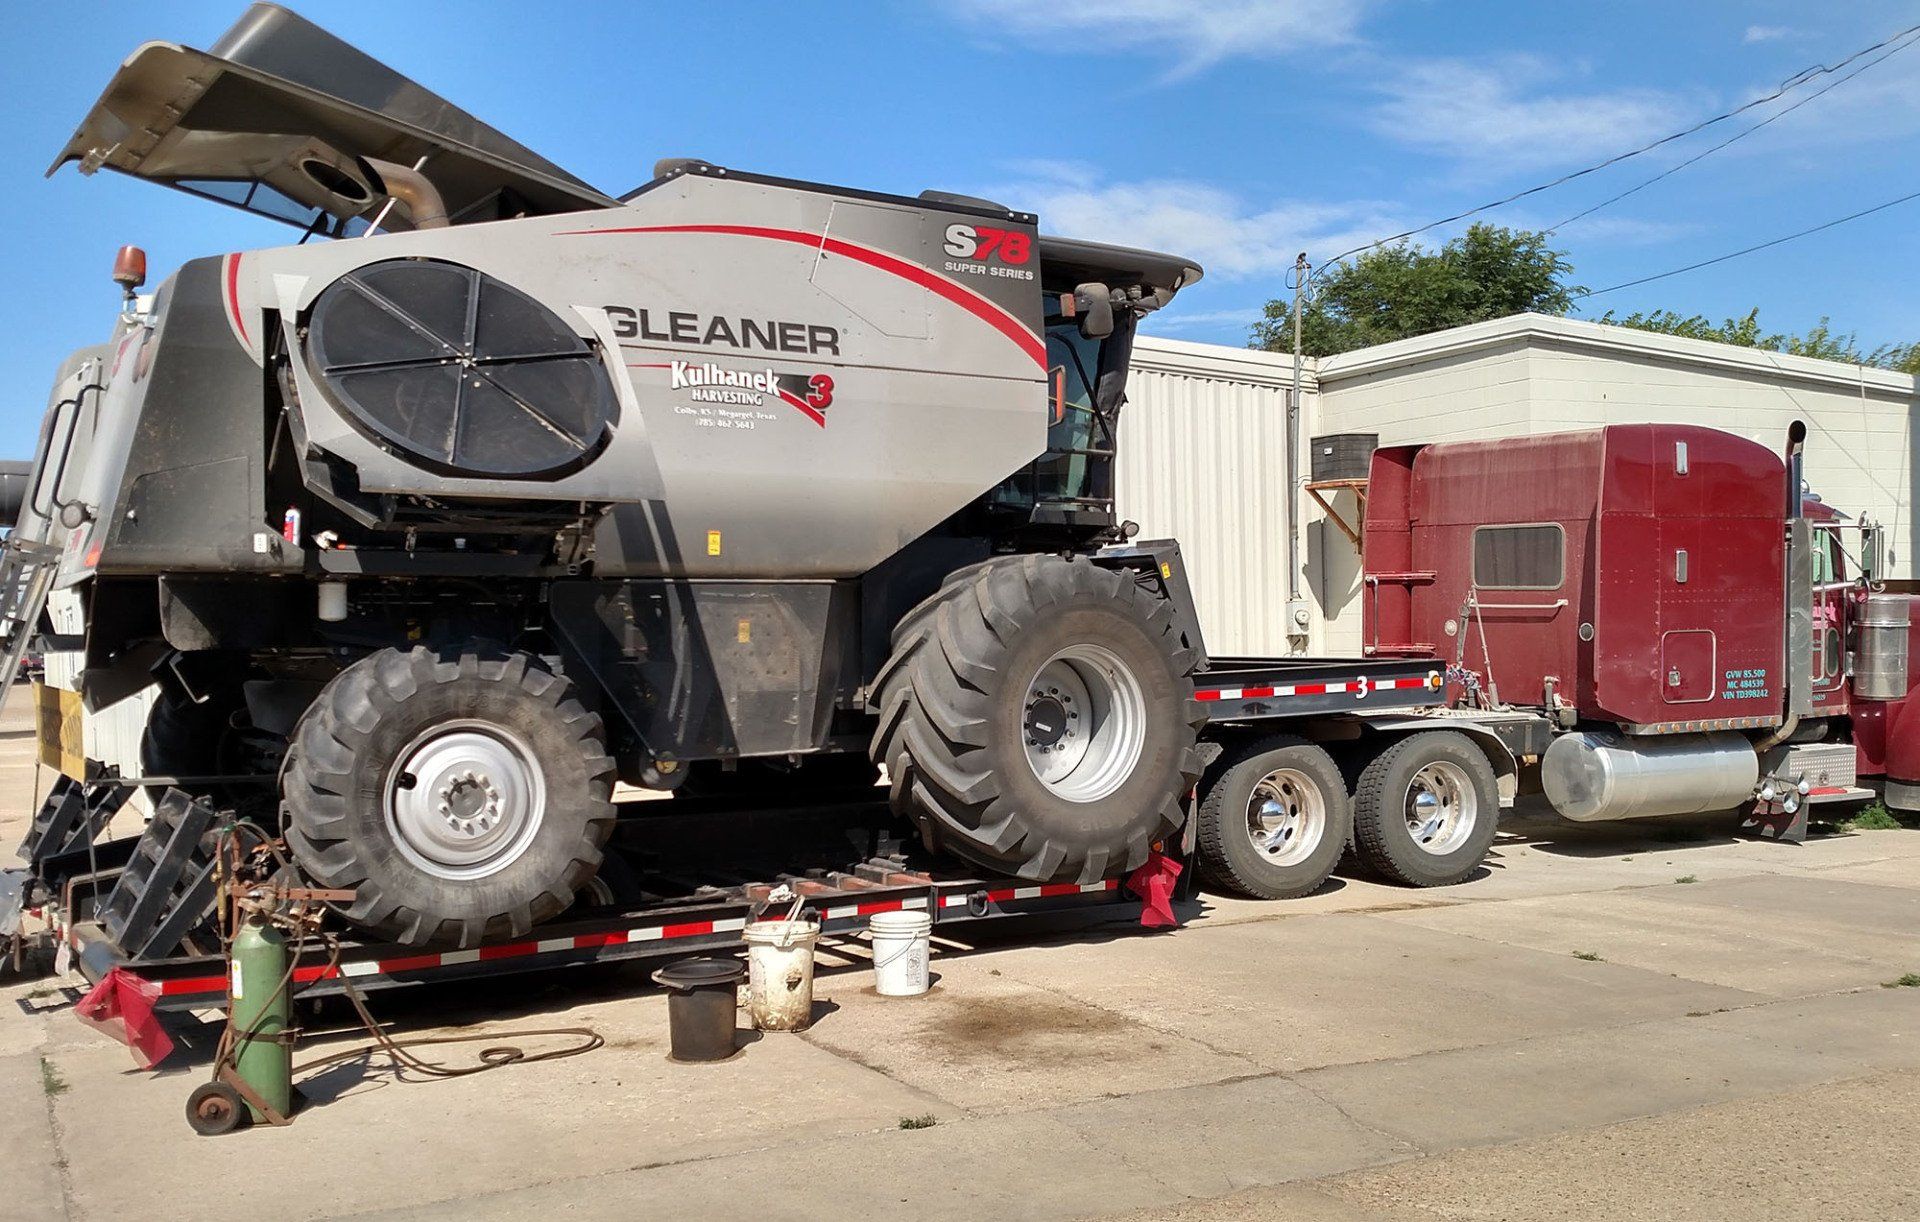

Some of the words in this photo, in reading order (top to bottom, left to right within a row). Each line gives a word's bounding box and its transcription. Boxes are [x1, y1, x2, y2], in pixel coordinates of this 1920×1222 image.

[944, 223, 1031, 265] S78
[944, 261, 986, 275] SUPER
[990, 267, 1034, 281] SERIES
[602, 305, 841, 356] GLEANER
[671, 360, 781, 397] Kulhanek
[691, 389, 763, 406] HARVESTING
[807, 373, 835, 409] 3
[756, 411, 778, 420] Texas
[1725, 670, 1742, 679] GVW
[1355, 675, 1368, 699] 3
[1727, 681, 1739, 689] MC
[1722, 691, 1735, 700] VIN
